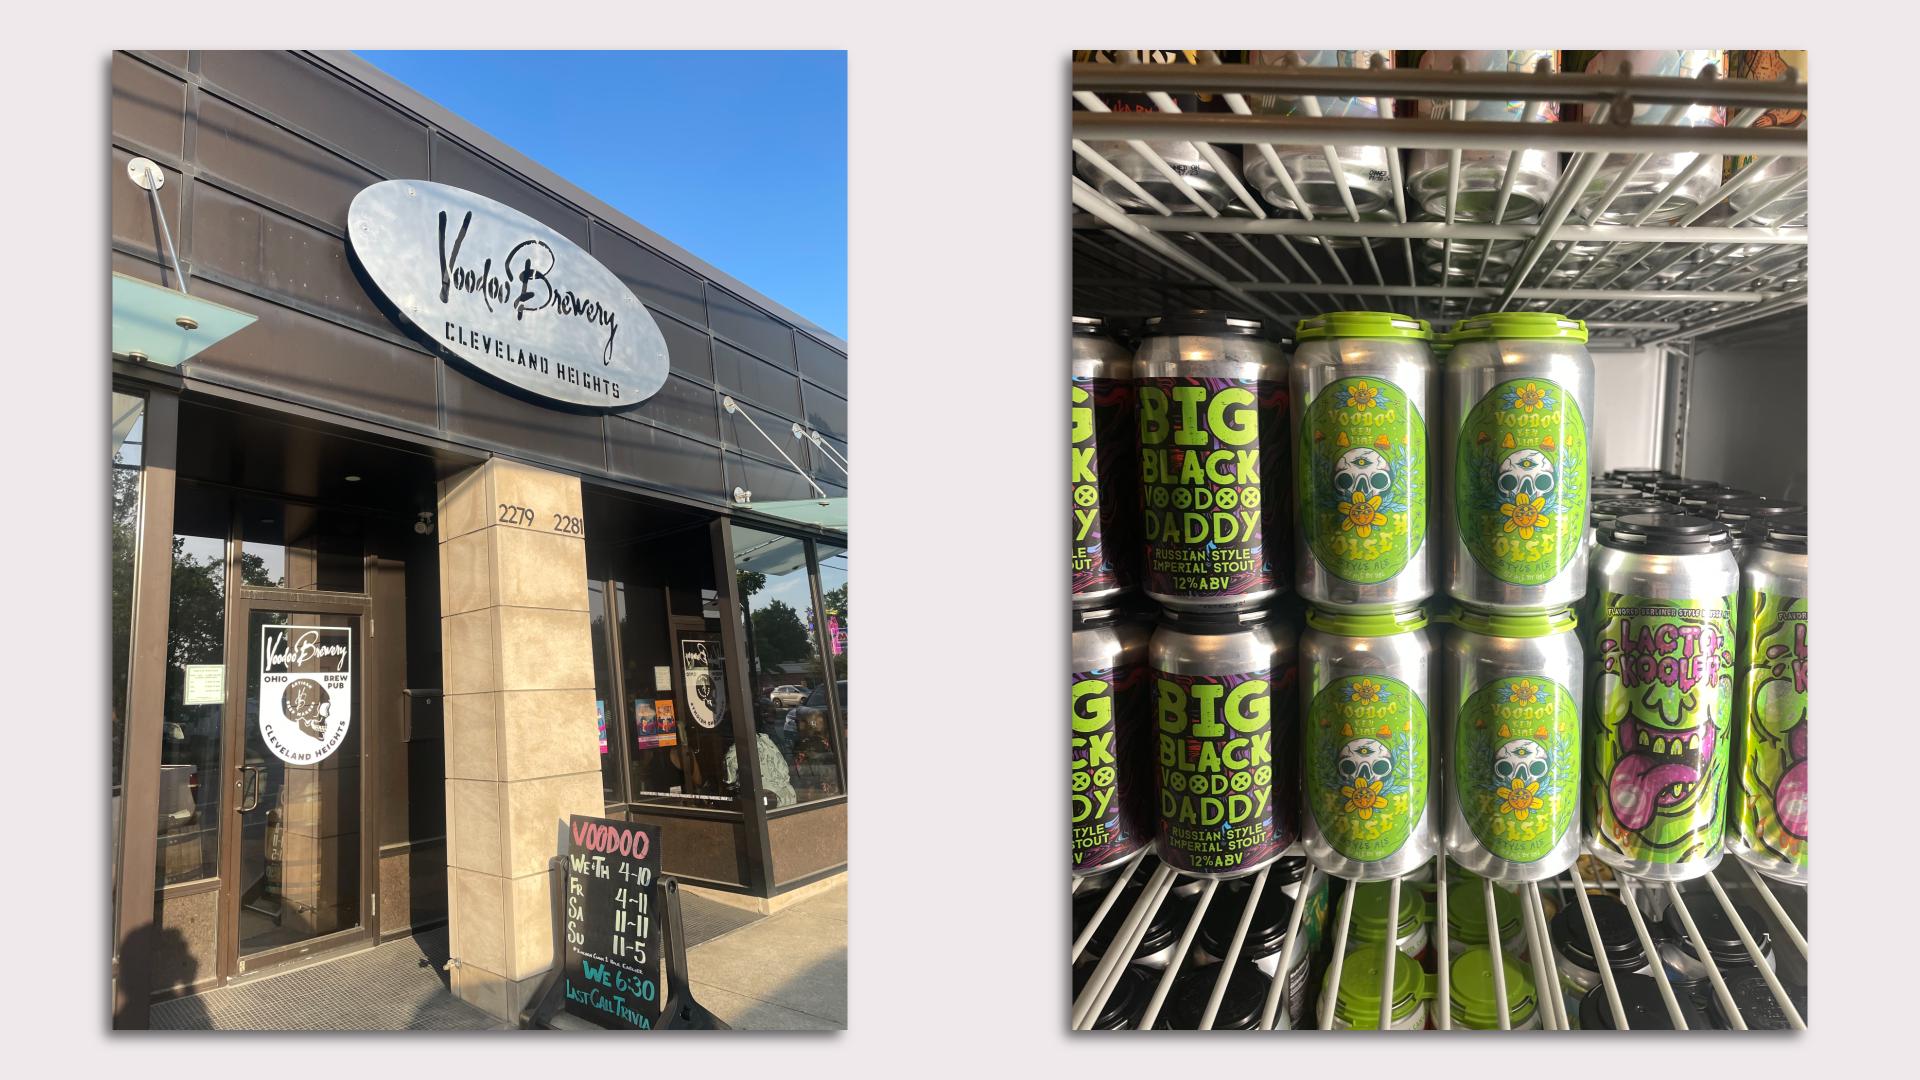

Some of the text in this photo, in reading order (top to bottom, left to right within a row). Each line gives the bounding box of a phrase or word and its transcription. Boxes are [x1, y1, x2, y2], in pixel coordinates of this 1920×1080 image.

[438, 210, 618, 366] Voodoo Brewery
[445, 321, 620, 399] CLEVELAND HEIGHTS
[1139, 386, 1259, 446] BIG
[1328, 409, 1396, 428] VOODOO
[1494, 410, 1561, 429] VOODOO
[1350, 436, 1373, 445] LIME
[1516, 437, 1540, 447] LIME
[1142, 448, 1261, 485] BLACK
[1144, 484, 1261, 510] VOODOO
[498, 503, 584, 535] 2279 2281
[1145, 509, 1262, 544] DADDY
[1153, 560, 1255, 574] IMPERIAL STOUT
[1155, 548, 1251, 562] RUSSIAN STYLE
[1338, 558, 1390, 571] STYLE ALE
[1496, 558, 1551, 573] STYLE ALE
[1607, 607, 1639, 618] FLAVORED
[1641, 607, 1676, 617] BERLINER
[1677, 608, 1700, 618] STYLE
[265, 630, 347, 672] Voodoo Brewery
[1619, 653, 1721, 694] KOOLER
[1157, 678, 1271, 737] BIG
[1334, 701, 1397, 719] VOODOO
[1490, 702, 1554, 720] VOODOO
[264, 720, 346, 761] CLEVELAND HEIGHTS
[1354, 727, 1376, 736] LIME
[1511, 728, 1534, 737] LIME
[1159, 730, 1272, 773] BLACK
[1161, 765, 1273, 795] VOODOO
[1161, 784, 1273, 826] DADDY
[572, 821, 650, 860] VOODOO
[1169, 832, 1267, 852] IMPERIAL STOUT
[1172, 822, 1263, 842] RUSSIAN STYLE
[1340, 836, 1390, 850] STYLE ALE
[1494, 835, 1545, 851] STYLE ALE
[570, 876, 584, 897] FR
[568, 896, 584, 922] SA
[567, 920, 585, 945] SU
[582, 960, 655, 1002] WE 6:30
[566, 979, 651, 1030] LAST CALL TRIVIA
